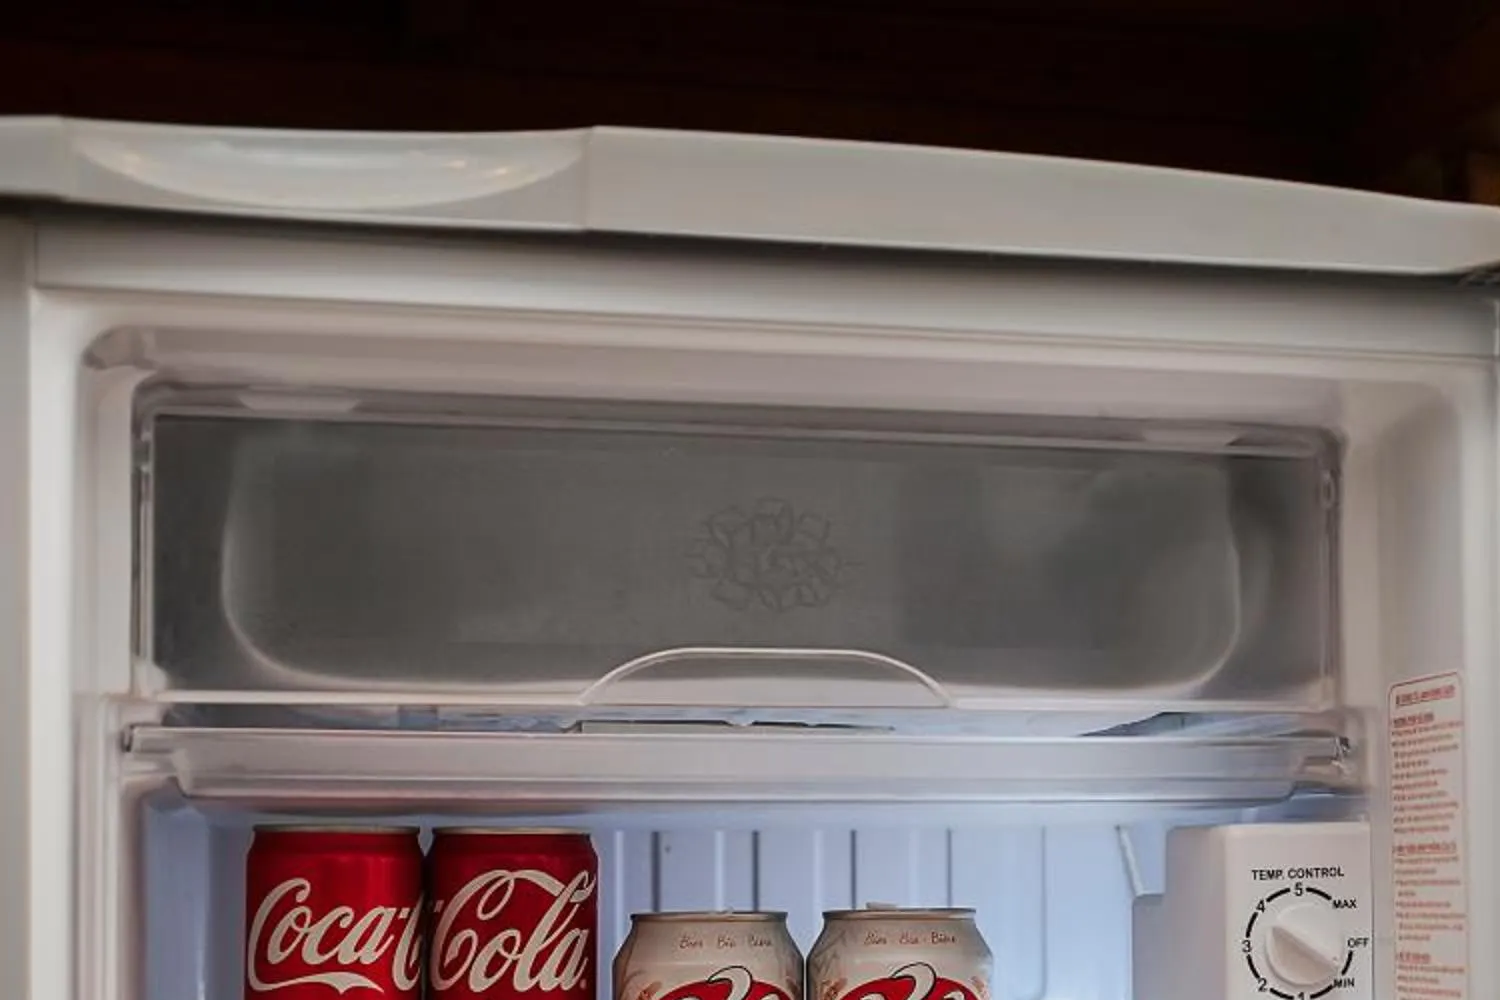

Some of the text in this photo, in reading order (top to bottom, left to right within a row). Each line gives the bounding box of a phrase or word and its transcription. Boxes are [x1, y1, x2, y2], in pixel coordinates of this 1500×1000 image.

[1251, 867, 1345, 881] TEMP. CONTROL
[1294, 882, 1304, 897] 5
[1256, 900, 1266, 913] 4
[1332, 899, 1357, 909] MAX
[1242, 939, 1252, 953] 3
[1347, 937, 1369, 948] OFF
[1258, 977, 1268, 992] 2
[1333, 978, 1355, 988] MIN
